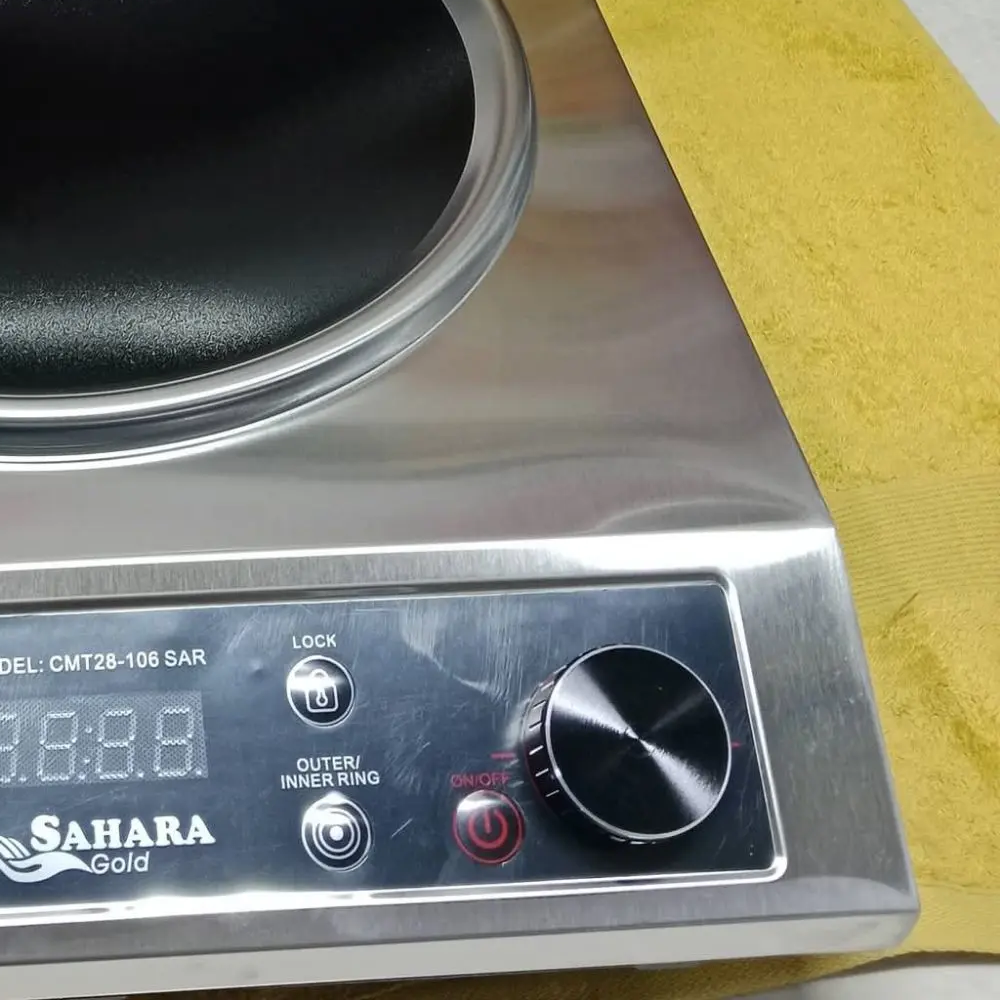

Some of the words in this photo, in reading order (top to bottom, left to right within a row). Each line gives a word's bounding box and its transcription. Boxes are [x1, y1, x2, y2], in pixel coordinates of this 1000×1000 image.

[292, 633, 338, 649] LOCK
[49, 651, 160, 674] CMT28-106
[164, 648, 207, 667] SAR
[296, 755, 361, 773] OUTER/
[280, 773, 334, 789] INNER
[337, 770, 381, 787] RING
[451, 771, 511, 788] ON/OFF
[30, 814, 216, 852] SAHARA
[90, 851, 151, 875] Gold
